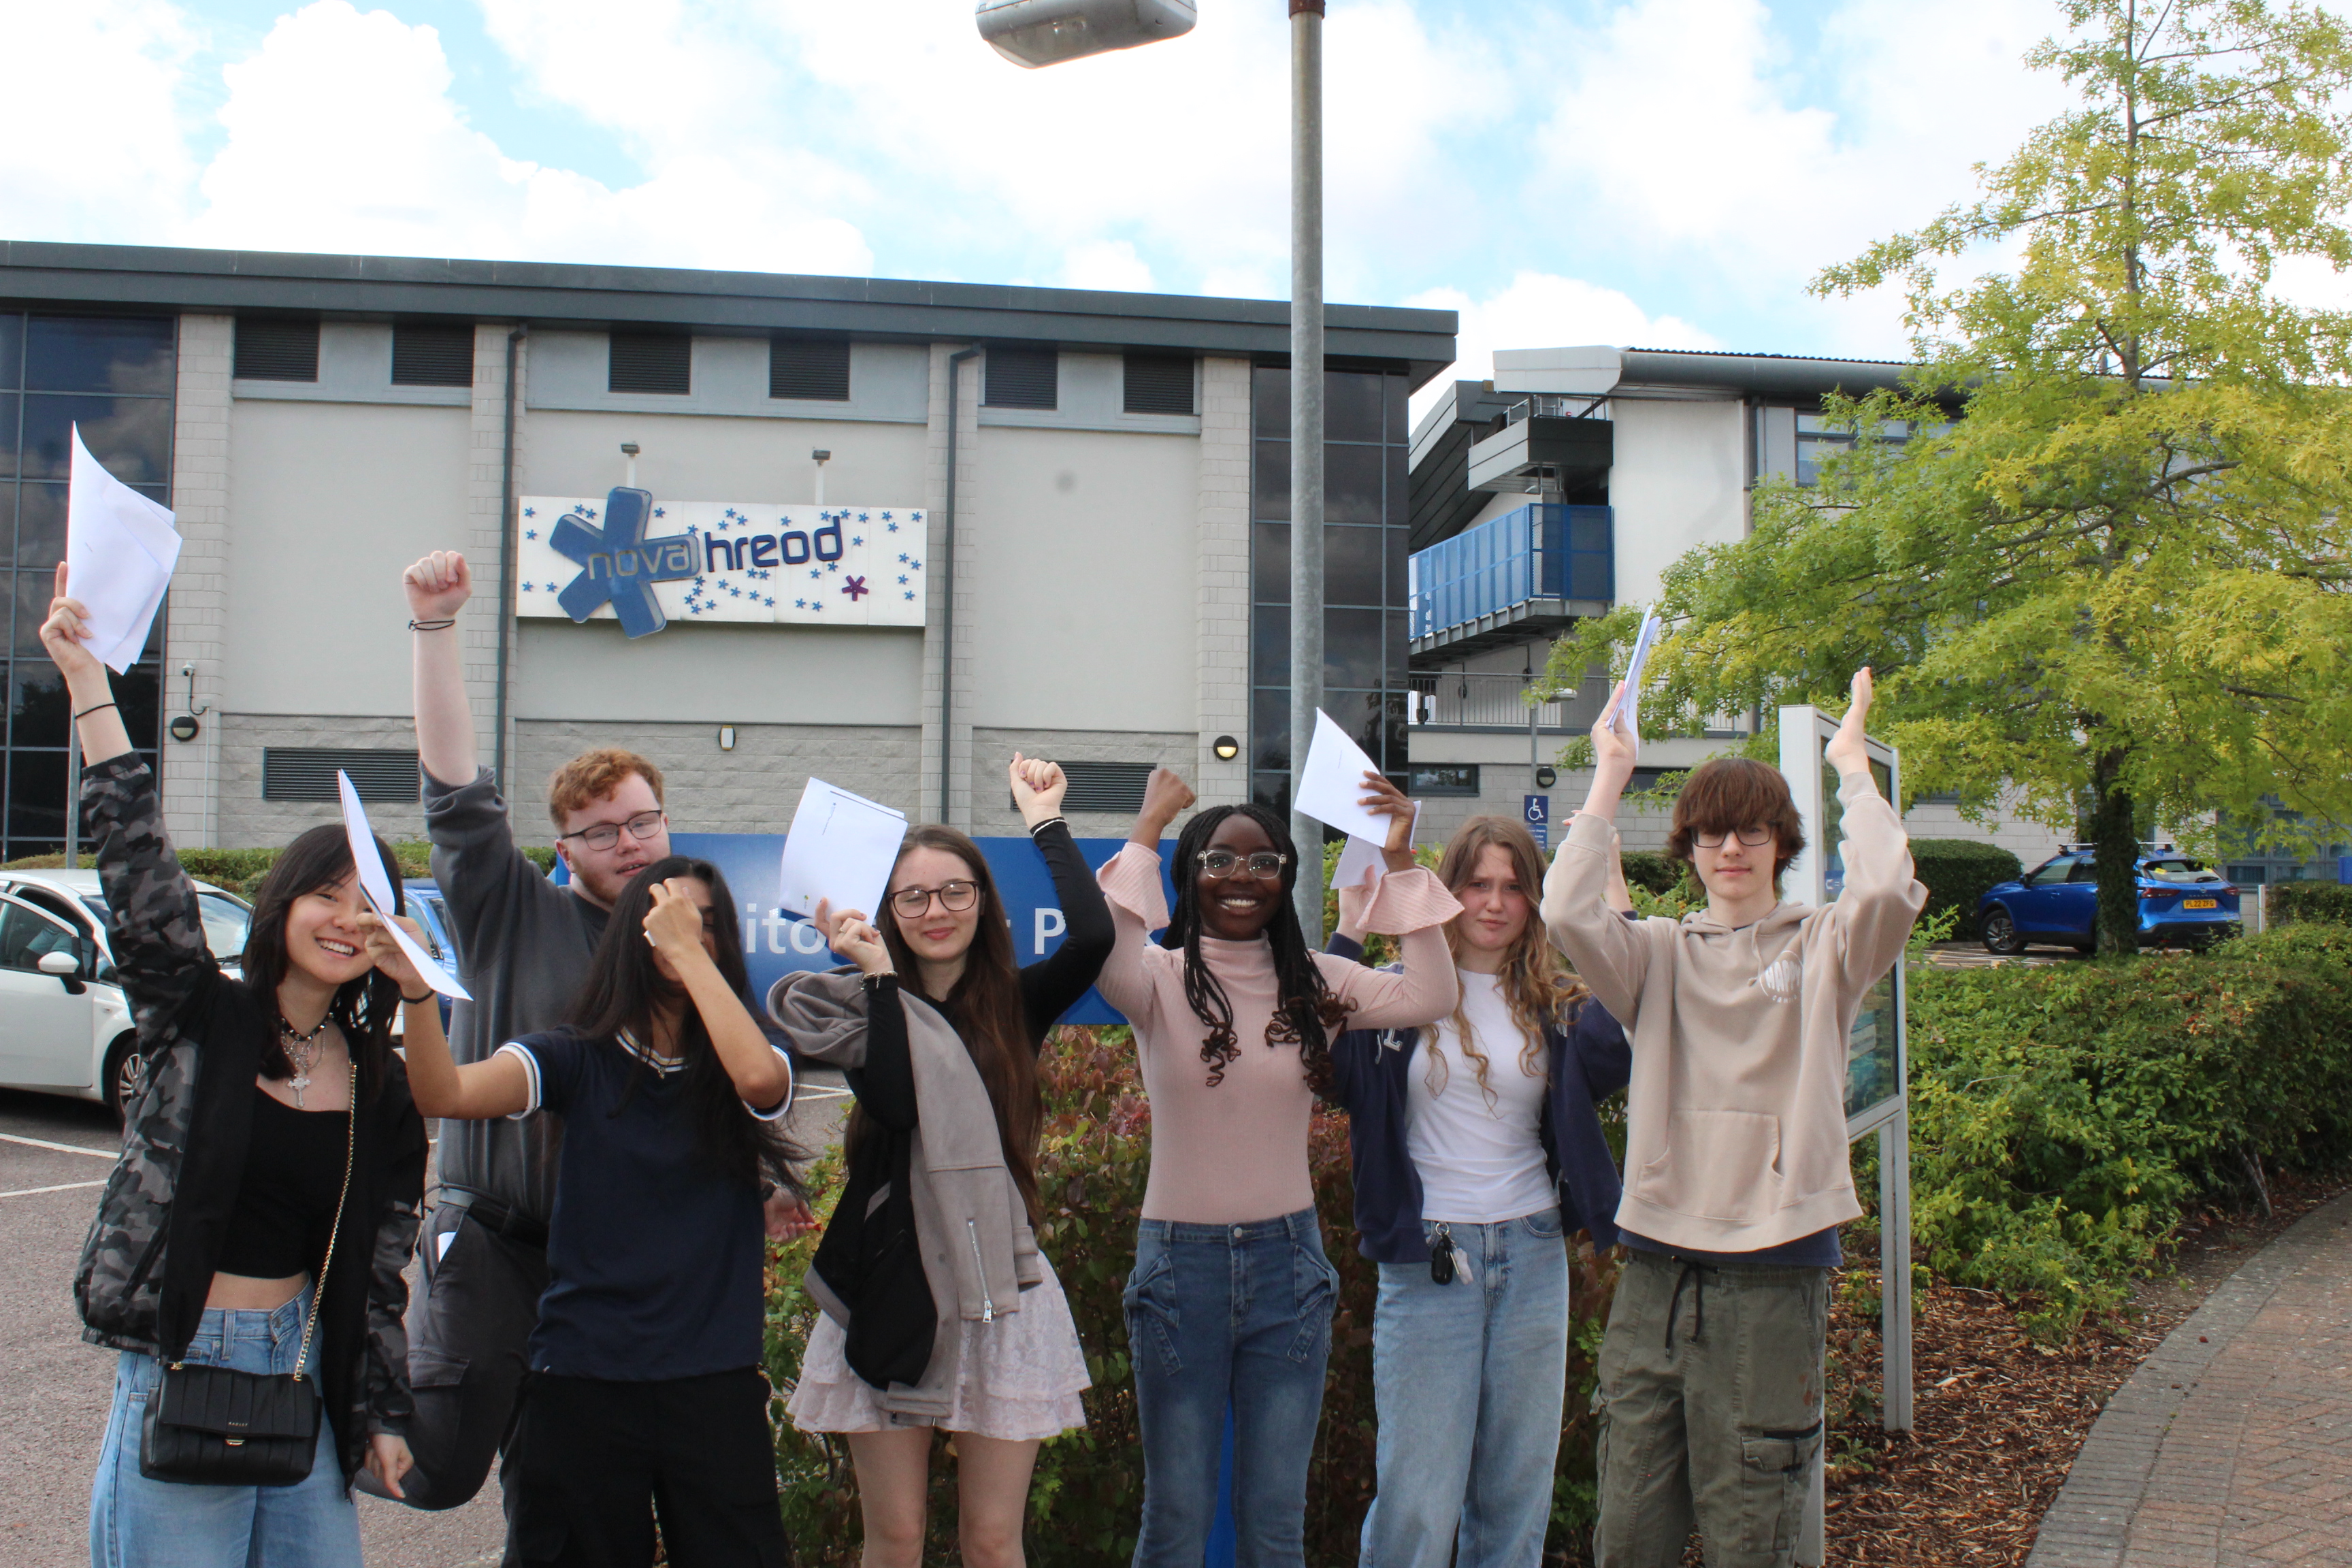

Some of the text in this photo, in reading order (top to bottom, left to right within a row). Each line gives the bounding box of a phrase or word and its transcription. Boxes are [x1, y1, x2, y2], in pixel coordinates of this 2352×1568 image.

[588, 515, 844, 580] nova hreod
[746, 902, 827, 955] ito
